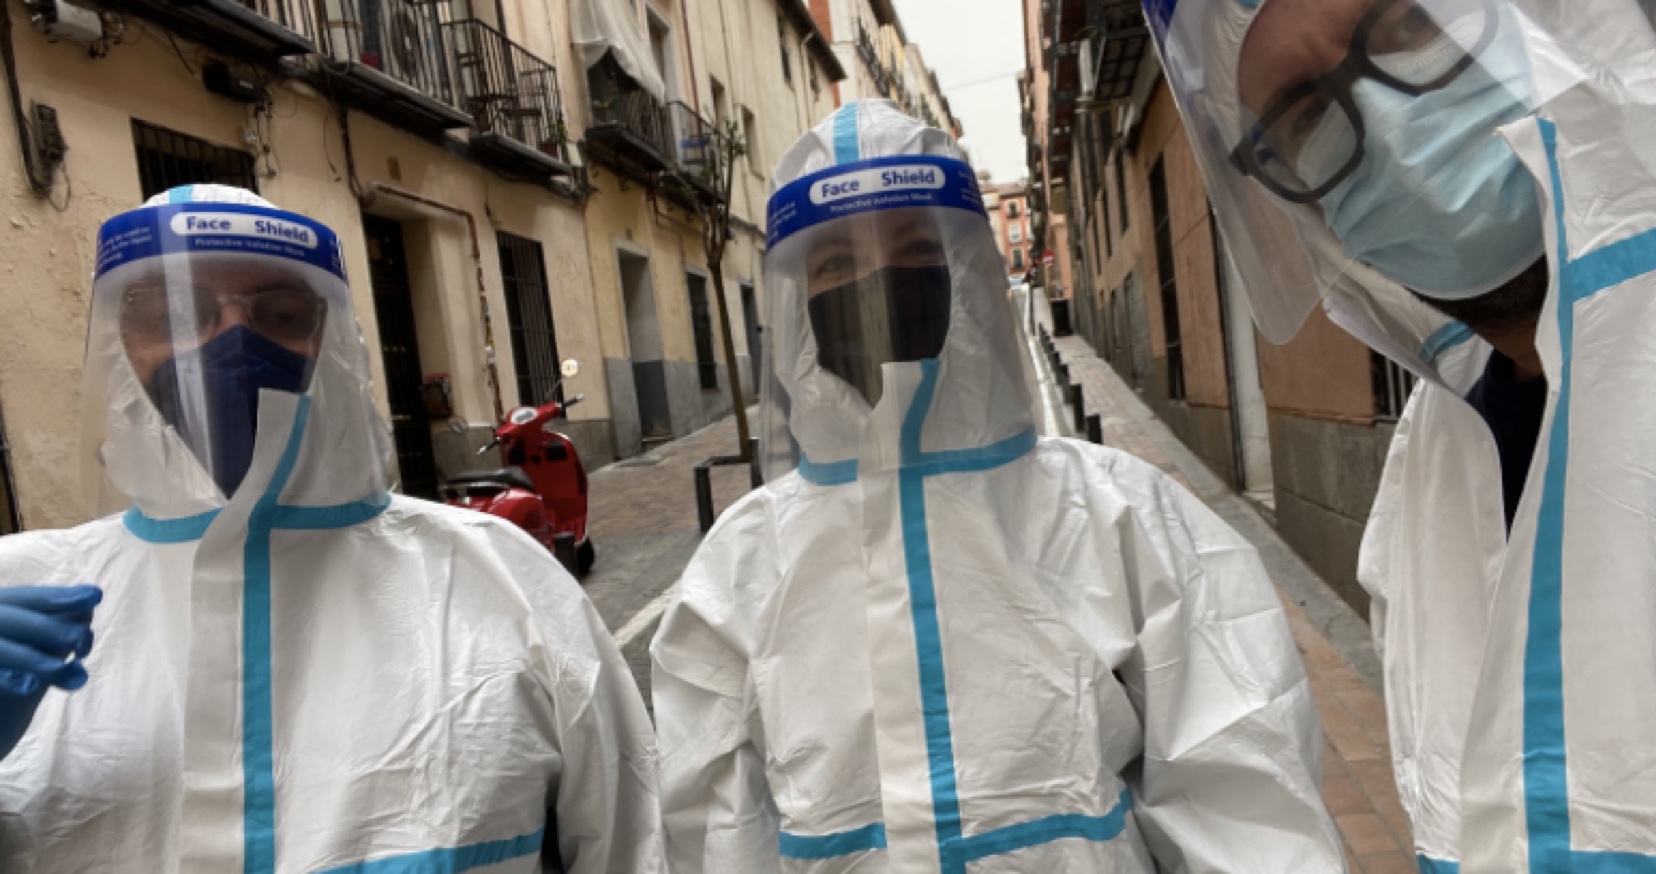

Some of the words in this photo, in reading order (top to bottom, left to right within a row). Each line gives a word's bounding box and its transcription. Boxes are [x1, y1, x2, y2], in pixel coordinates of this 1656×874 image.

[821, 179, 860, 197] Face
[882, 169, 935, 186] Shield
[186, 216, 231, 230] Face
[255, 220, 309, 243] Shield
